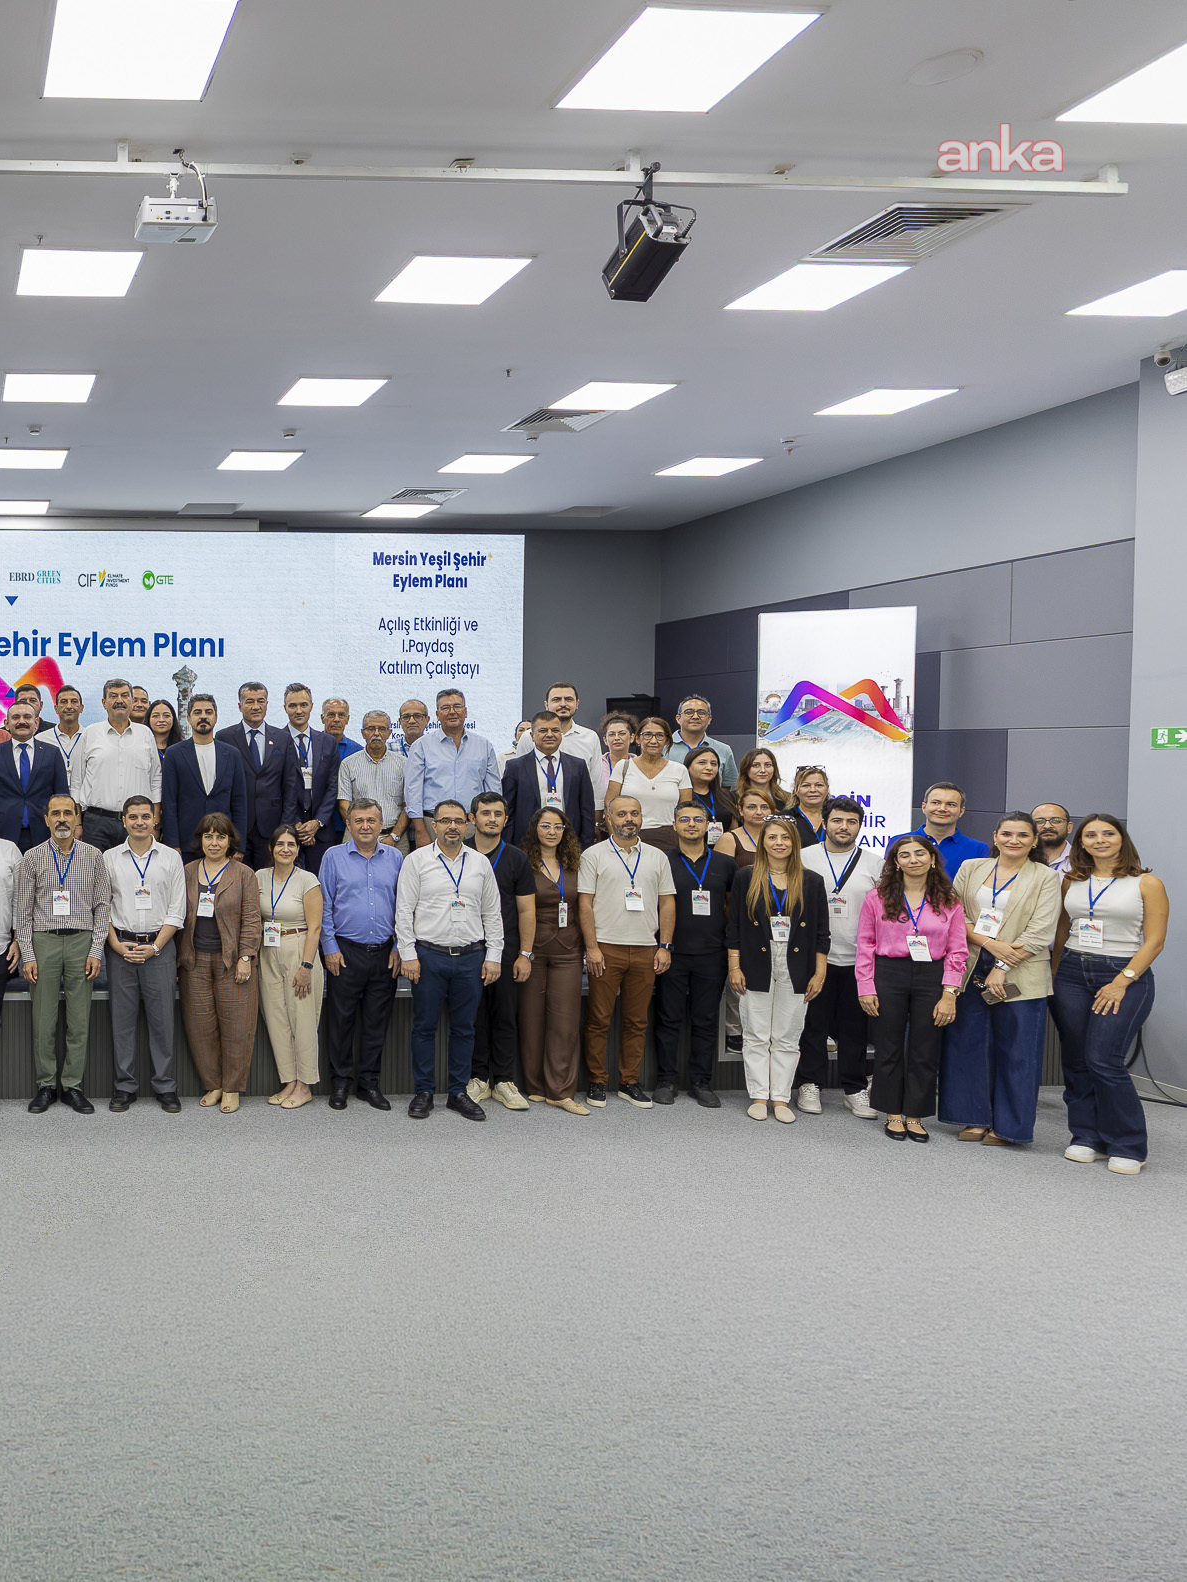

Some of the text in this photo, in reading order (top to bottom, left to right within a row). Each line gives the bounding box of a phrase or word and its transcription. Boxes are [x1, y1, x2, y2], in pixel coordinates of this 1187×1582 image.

[372, 550, 487, 571] Mersin Yeşil Şehir
[9, 572, 35, 582] EBRD
[77, 573, 97, 588] CIF
[156, 575, 174, 585] GTE
[393, 573, 468, 592] Eylem Planı
[378, 616, 478, 635] Açılış Etkinliği ve
[58, 631, 146, 666] Eylem
[154, 632, 225, 657] Planı
[402, 639, 454, 657] I.Paydaş
[379, 660, 480, 679] Katılım Çalıştayı
[862, 812, 886, 828] HİR
